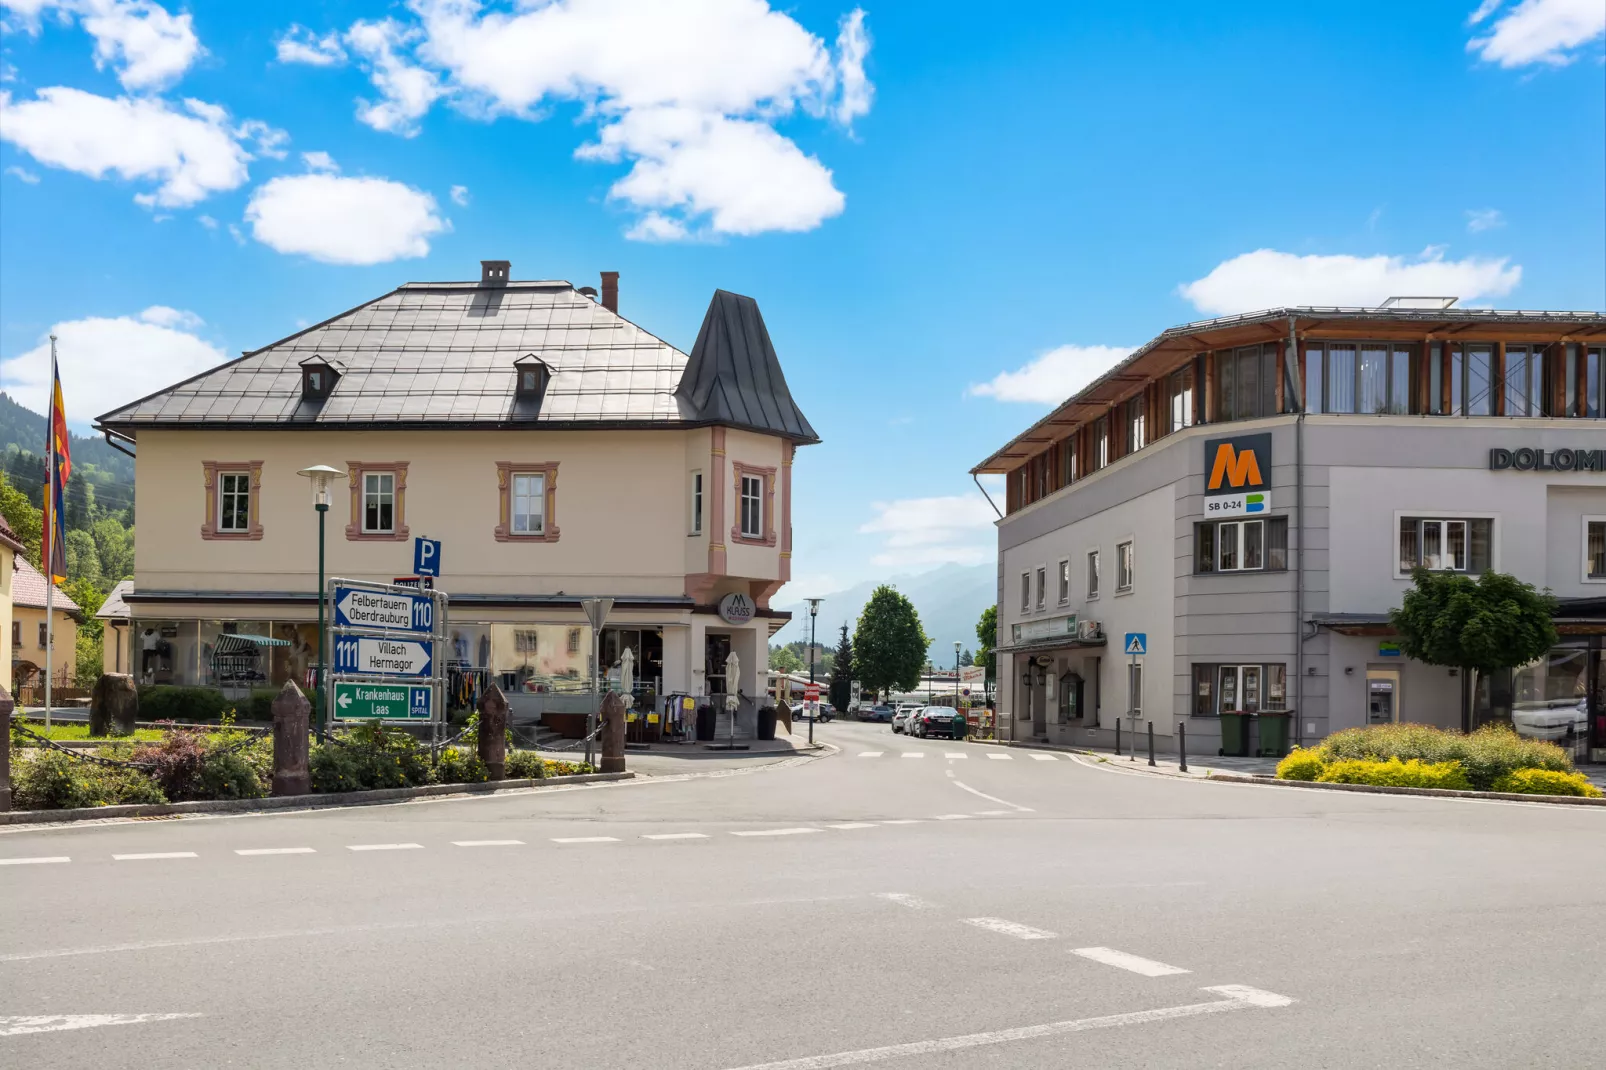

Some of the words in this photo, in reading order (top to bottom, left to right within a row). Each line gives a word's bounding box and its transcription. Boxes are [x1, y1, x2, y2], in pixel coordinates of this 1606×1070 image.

[1208, 502, 1221, 511] SB
[1223, 501, 1242, 510] 0-24
[421, 540, 435, 566] P
[351, 593, 408, 611] Felbertauern
[349, 607, 409, 627] Oberdrauburg
[413, 602, 432, 627] 110
[336, 641, 358, 668] 111
[378, 642, 407, 656] Villach
[369, 655, 414, 672] Hermagor
[355, 687, 405, 701] Krankenhaus
[415, 690, 426, 706] H
[371, 702, 390, 715] Laas
[411, 706, 428, 714] SPITAL
